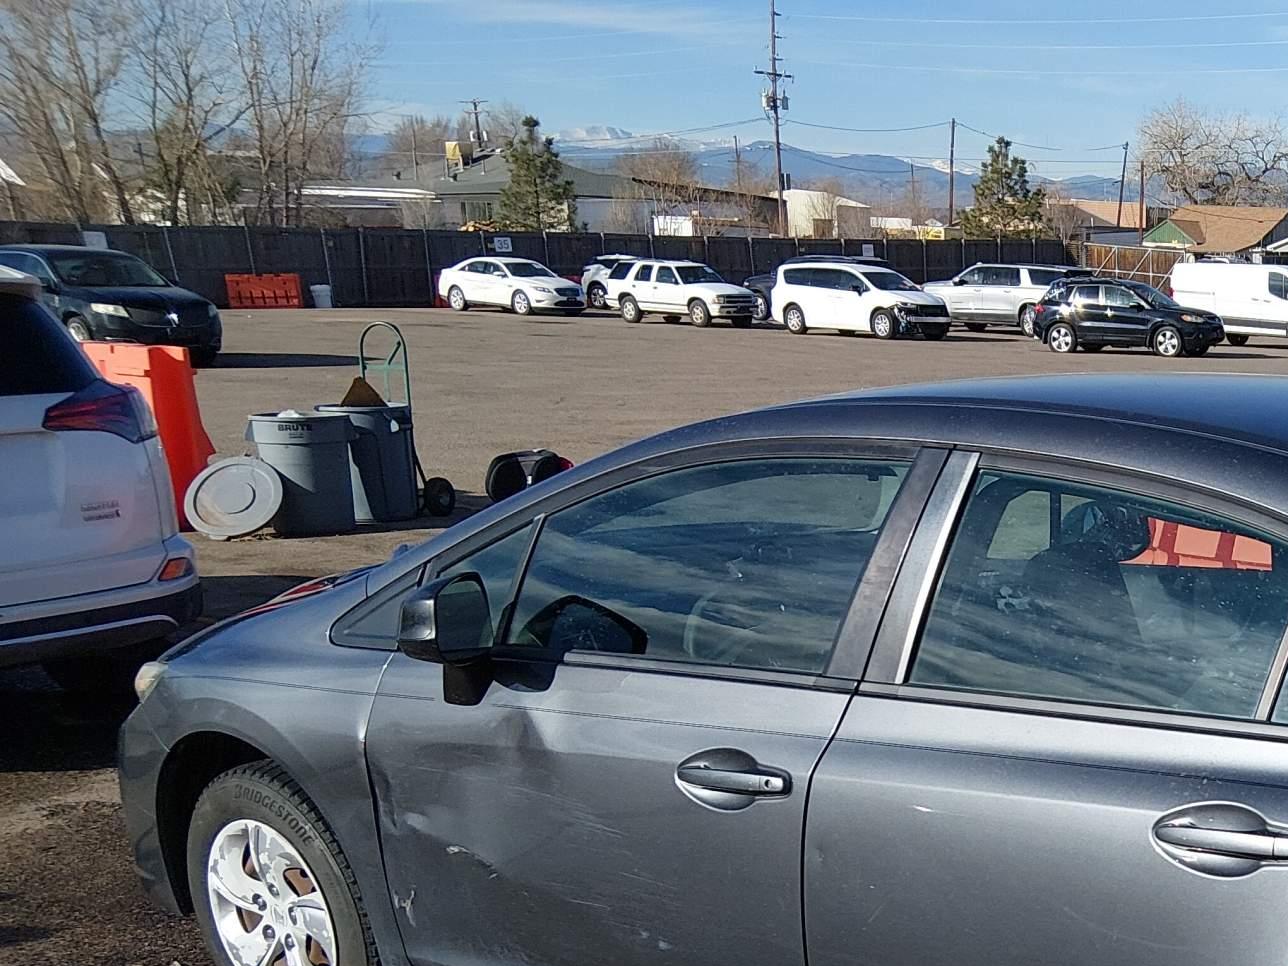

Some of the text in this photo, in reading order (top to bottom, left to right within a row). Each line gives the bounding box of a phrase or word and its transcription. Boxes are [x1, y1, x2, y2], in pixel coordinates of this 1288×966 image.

[496, 239, 510, 250] 35
[277, 423, 313, 432] BRUTE
[233, 783, 315, 847] BRIDGESTONE
